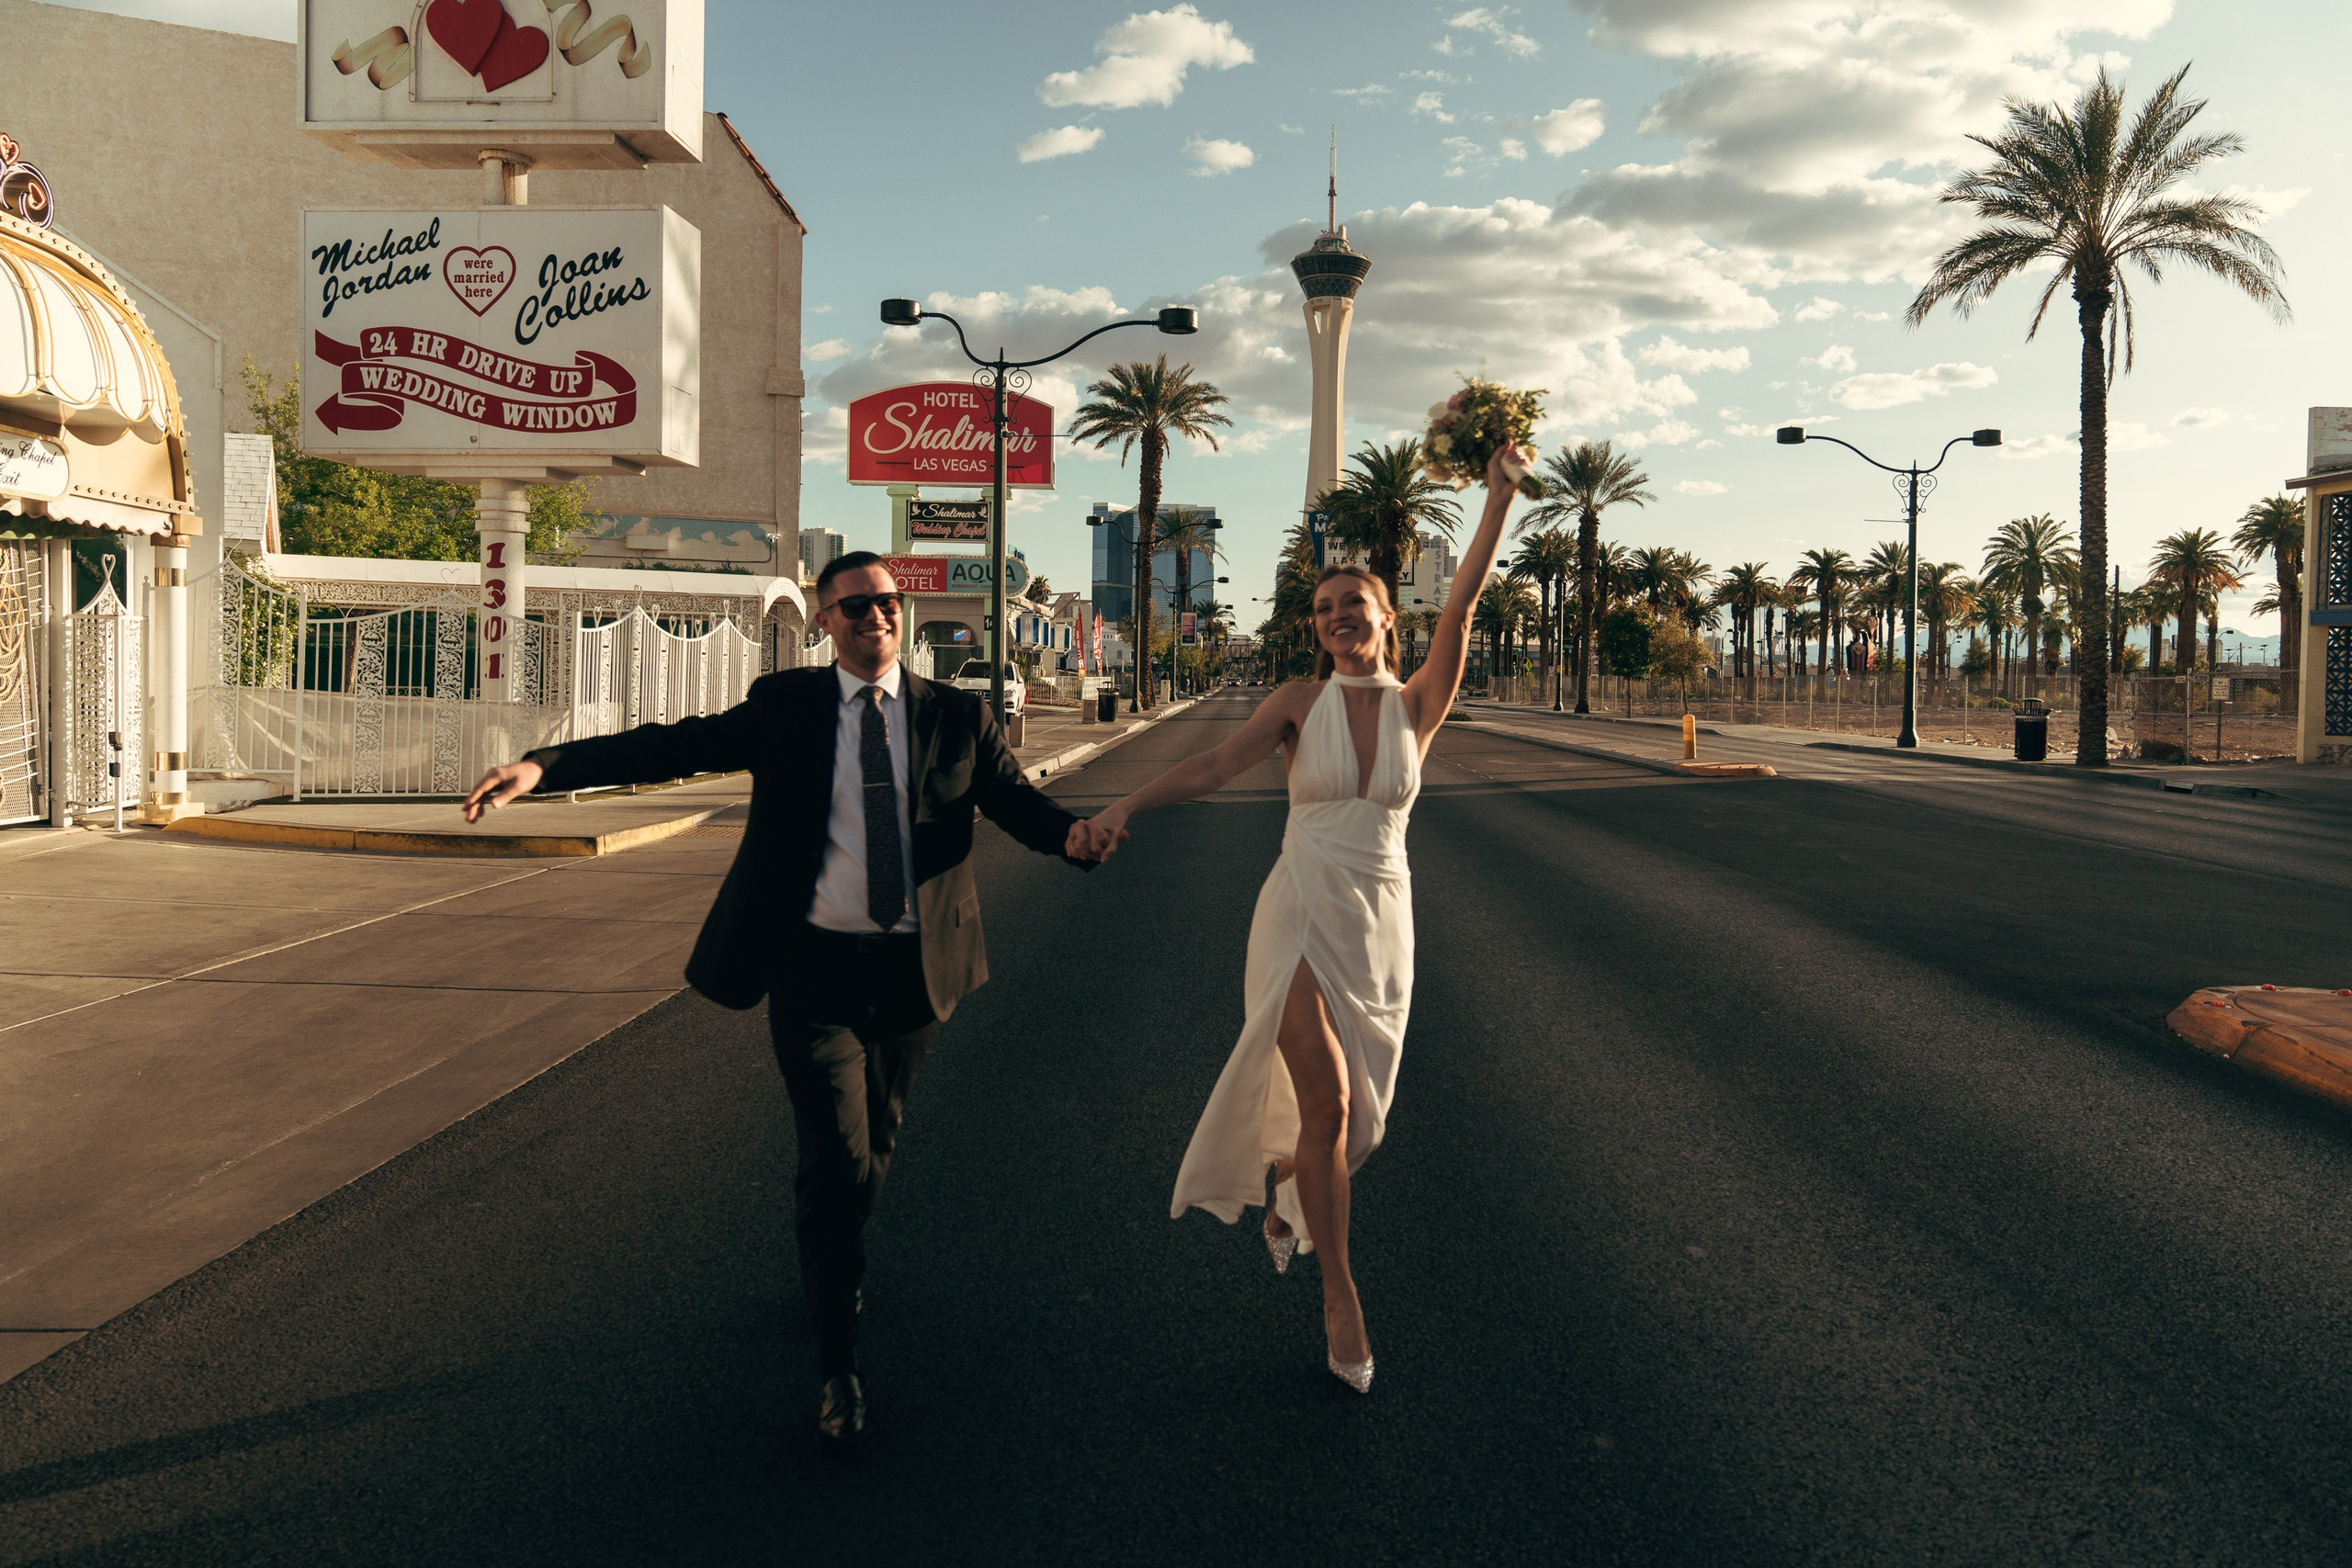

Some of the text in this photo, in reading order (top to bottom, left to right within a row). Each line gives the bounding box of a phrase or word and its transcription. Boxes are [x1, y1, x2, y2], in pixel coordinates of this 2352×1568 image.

[311, 216, 441, 276] Michael
[464, 259, 493, 269] were
[453, 271, 504, 284] married
[538, 246, 624, 308] Joan
[322, 260, 432, 319] Jordan
[465, 286, 493, 298] here
[514, 276, 651, 345] Collins
[369, 331, 583, 394] 24 HR DRIVE UP
[359, 367, 617, 430] WEDDING WINDOW
[923, 391, 979, 409] HOTEL
[864, 401, 1037, 455] Shalimar
[18, 440, 58, 468] Chapel
[913, 457, 987, 472] LAS VEGAS
[922, 503, 977, 519] Shalimar
[911, 521, 987, 539] Wedding Chapel
[888, 558, 939, 576] Shalimar
[1333, 557, 1356, 565] LAS
[894, 576, 938, 590] OTEL
[1433, 550, 1442, 605] STRAT
[483, 542, 507, 680] 1301
